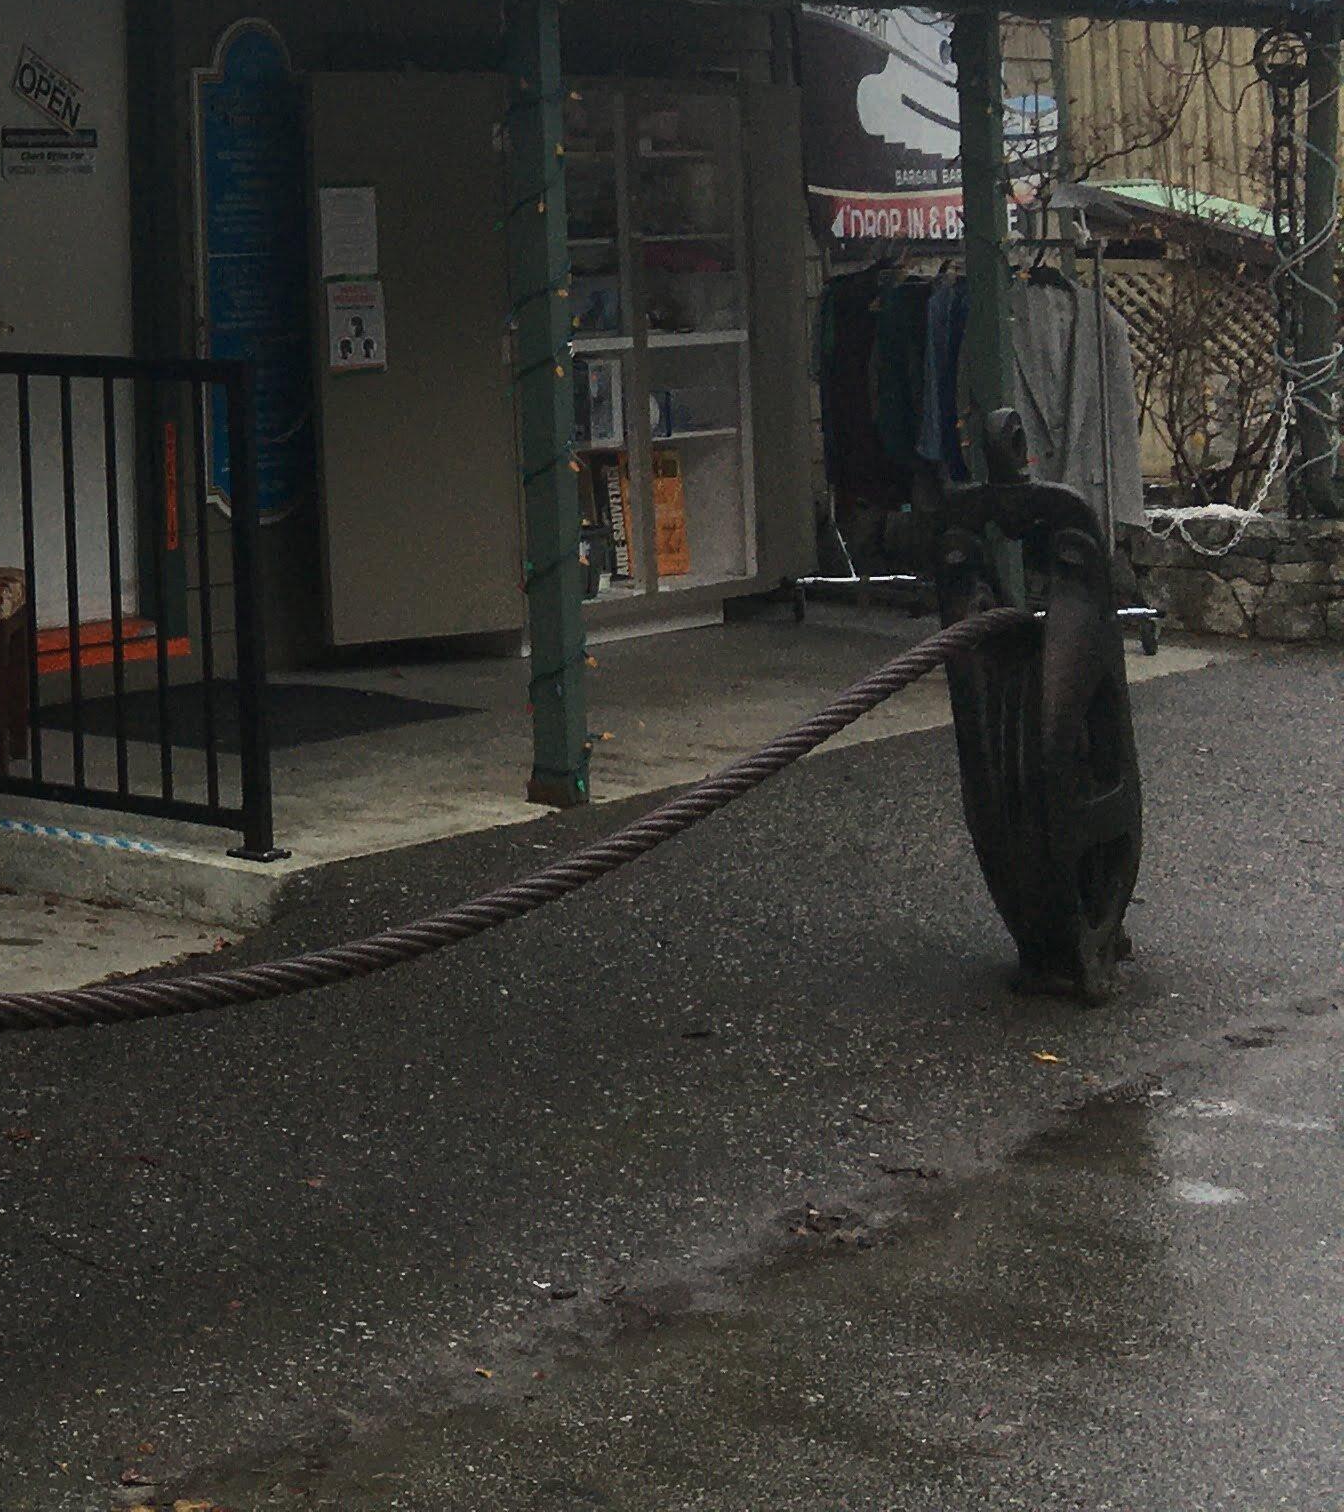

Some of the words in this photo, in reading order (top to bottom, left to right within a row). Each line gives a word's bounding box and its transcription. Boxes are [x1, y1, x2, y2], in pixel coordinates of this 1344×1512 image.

[18, 62, 82, 128] OPEN
[894, 168, 937, 186] BARGAIN
[942, 168, 963, 185] BAR
[850, 206, 902, 239] DROP
[907, 206, 925, 239] IN
[929, 206, 941, 239] &
